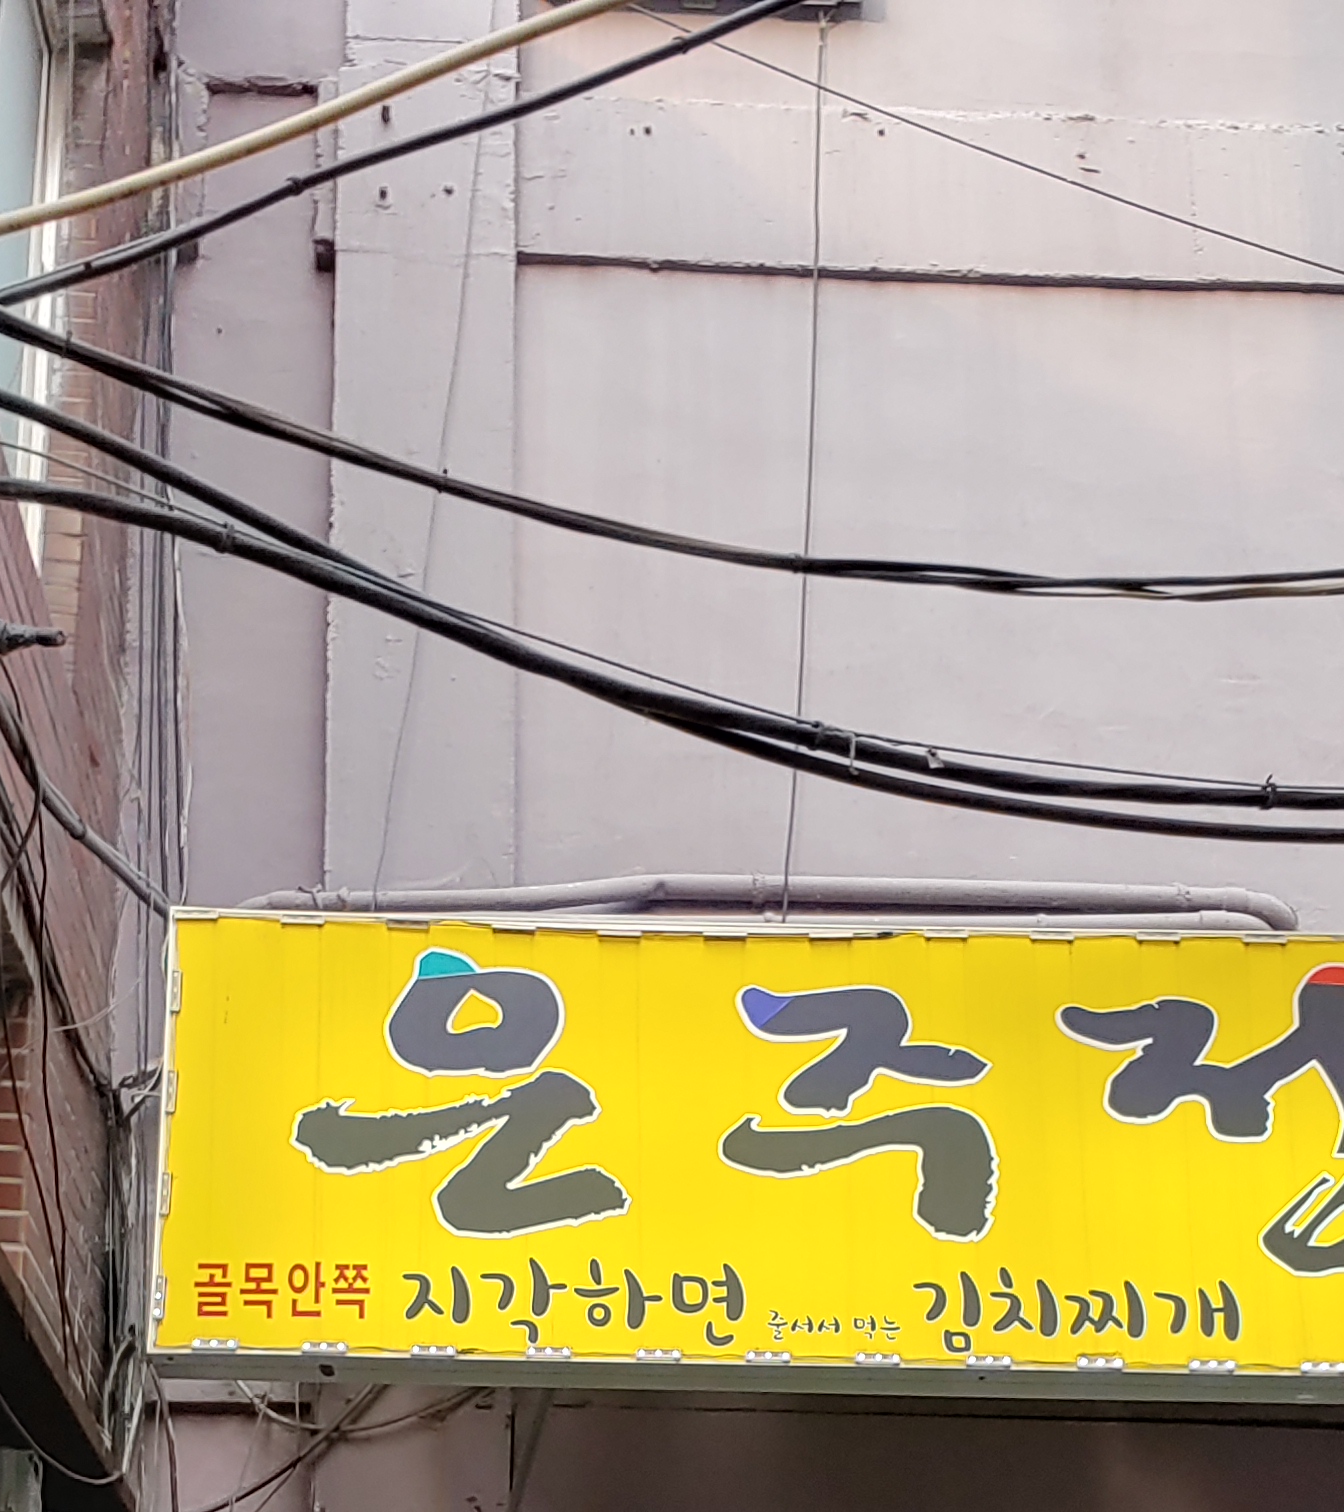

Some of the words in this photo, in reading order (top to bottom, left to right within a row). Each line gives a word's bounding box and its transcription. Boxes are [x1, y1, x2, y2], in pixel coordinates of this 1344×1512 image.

[193, 1261, 372, 1319] 골목안쪽
[402, 1257, 747, 1346] 지각하면
[767, 1309, 841, 1341] 줄서서
[853, 1315, 902, 1341] 먹는
[914, 1267, 1242, 1352] 김치찌개
